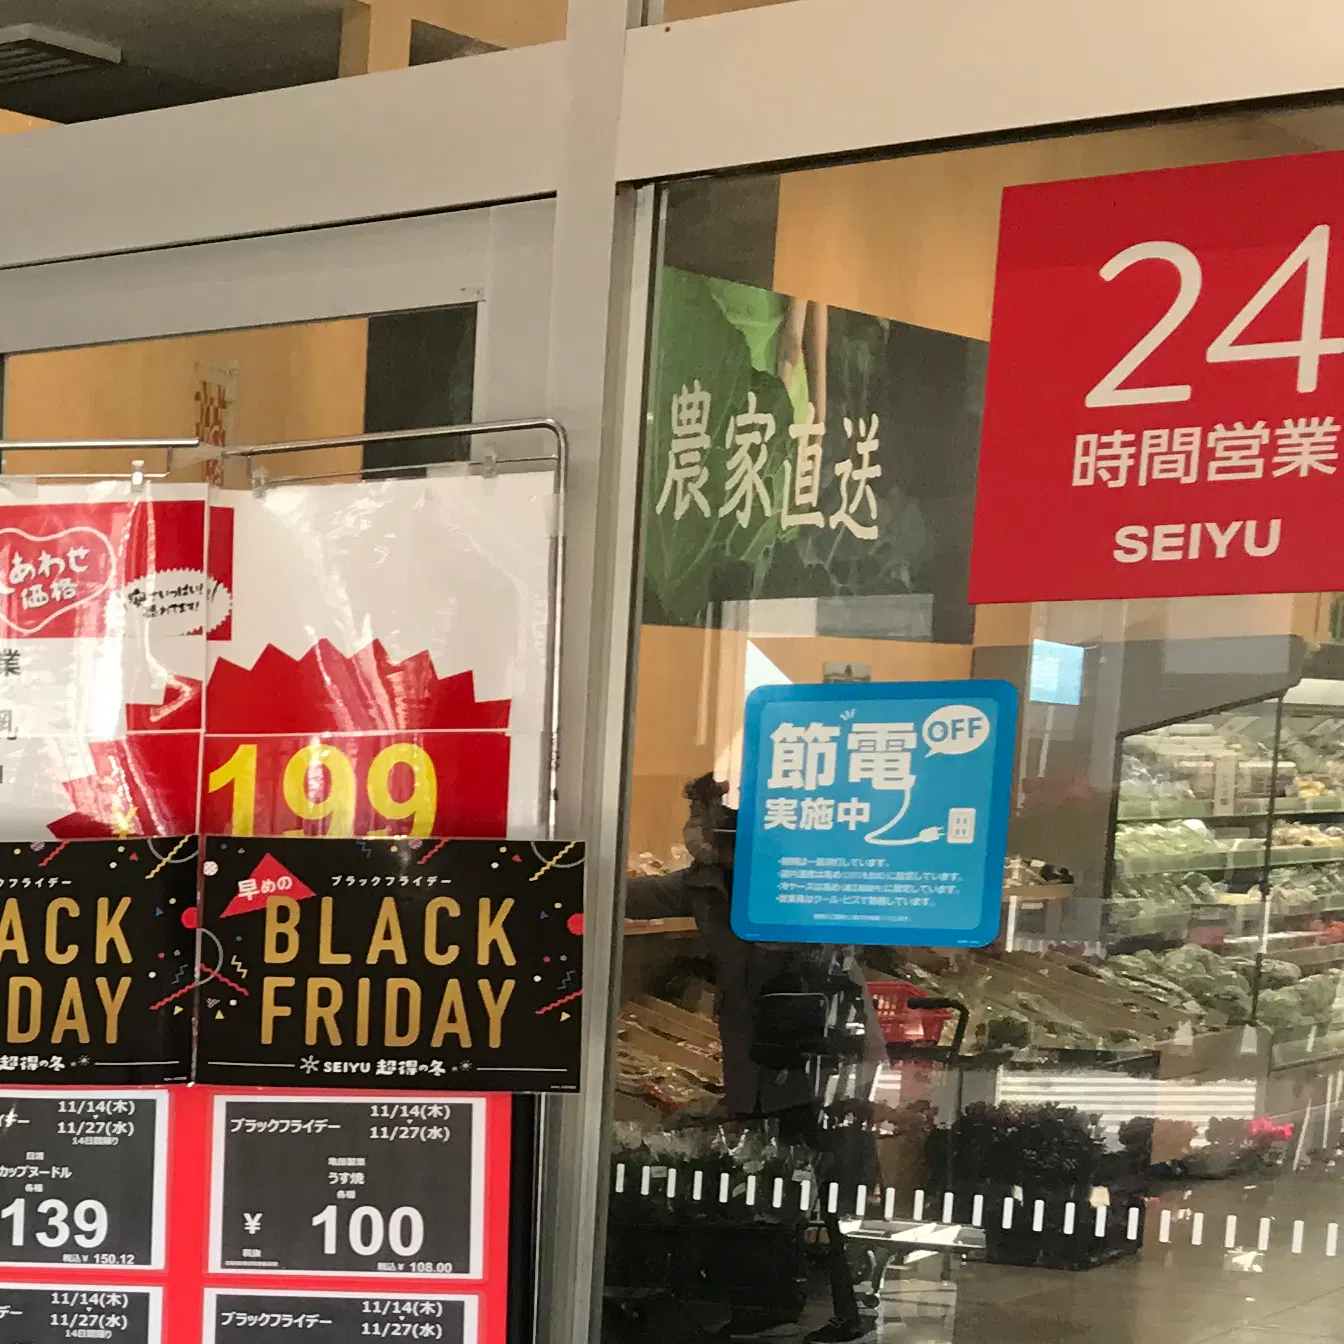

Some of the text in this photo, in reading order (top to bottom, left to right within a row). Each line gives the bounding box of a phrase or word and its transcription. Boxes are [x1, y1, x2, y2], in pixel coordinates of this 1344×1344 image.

[1084, 223, 1344, 409] 24
[657, 378, 882, 540] 農家直送
[1072, 416, 1341, 489] 時間営業
[1112, 517, 1282, 564] SEIYU
[21, 578, 78, 610] 価格
[927, 717, 982, 742] OFF
[767, 722, 917, 790] 節電
[207, 741, 439, 839] 199
[763, 797, 871, 831] 実施中
[238, 874, 293, 901] 早めの
[331, 874, 453, 888] ブラックフライデー
[262, 895, 516, 968] BLACK
[260, 977, 516, 1048] FRIDAY
[0, 1054, 66, 1072] 超得の冬
[323, 1058, 446, 1076] SEIYU 超得の冬
[57, 1100, 135, 1116] 11/14(木)
[370, 1104, 450, 1120] 11/14(木)
[56, 1121, 134, 1136] 11/27(水)
[230, 1118, 341, 1134] ブラックフライデー
[369, 1126, 450, 1141] 11/27(水)
[328, 1172, 365, 1185] うす焼
[0, 1198, 109, 1249] 139
[312, 1204, 424, 1256] 100
[93, 1254, 135, 1265] 150.12
[409, 1262, 453, 1273] 108.00
[50, 1292, 128, 1308] 11/14(木)
[362, 1301, 443, 1317] 11/14(木)
[50, 1314, 128, 1330] 11/27(水)
[221, 1312, 332, 1329] ブラックフライデー
[361, 1323, 443, 1340] 11/27(水)
